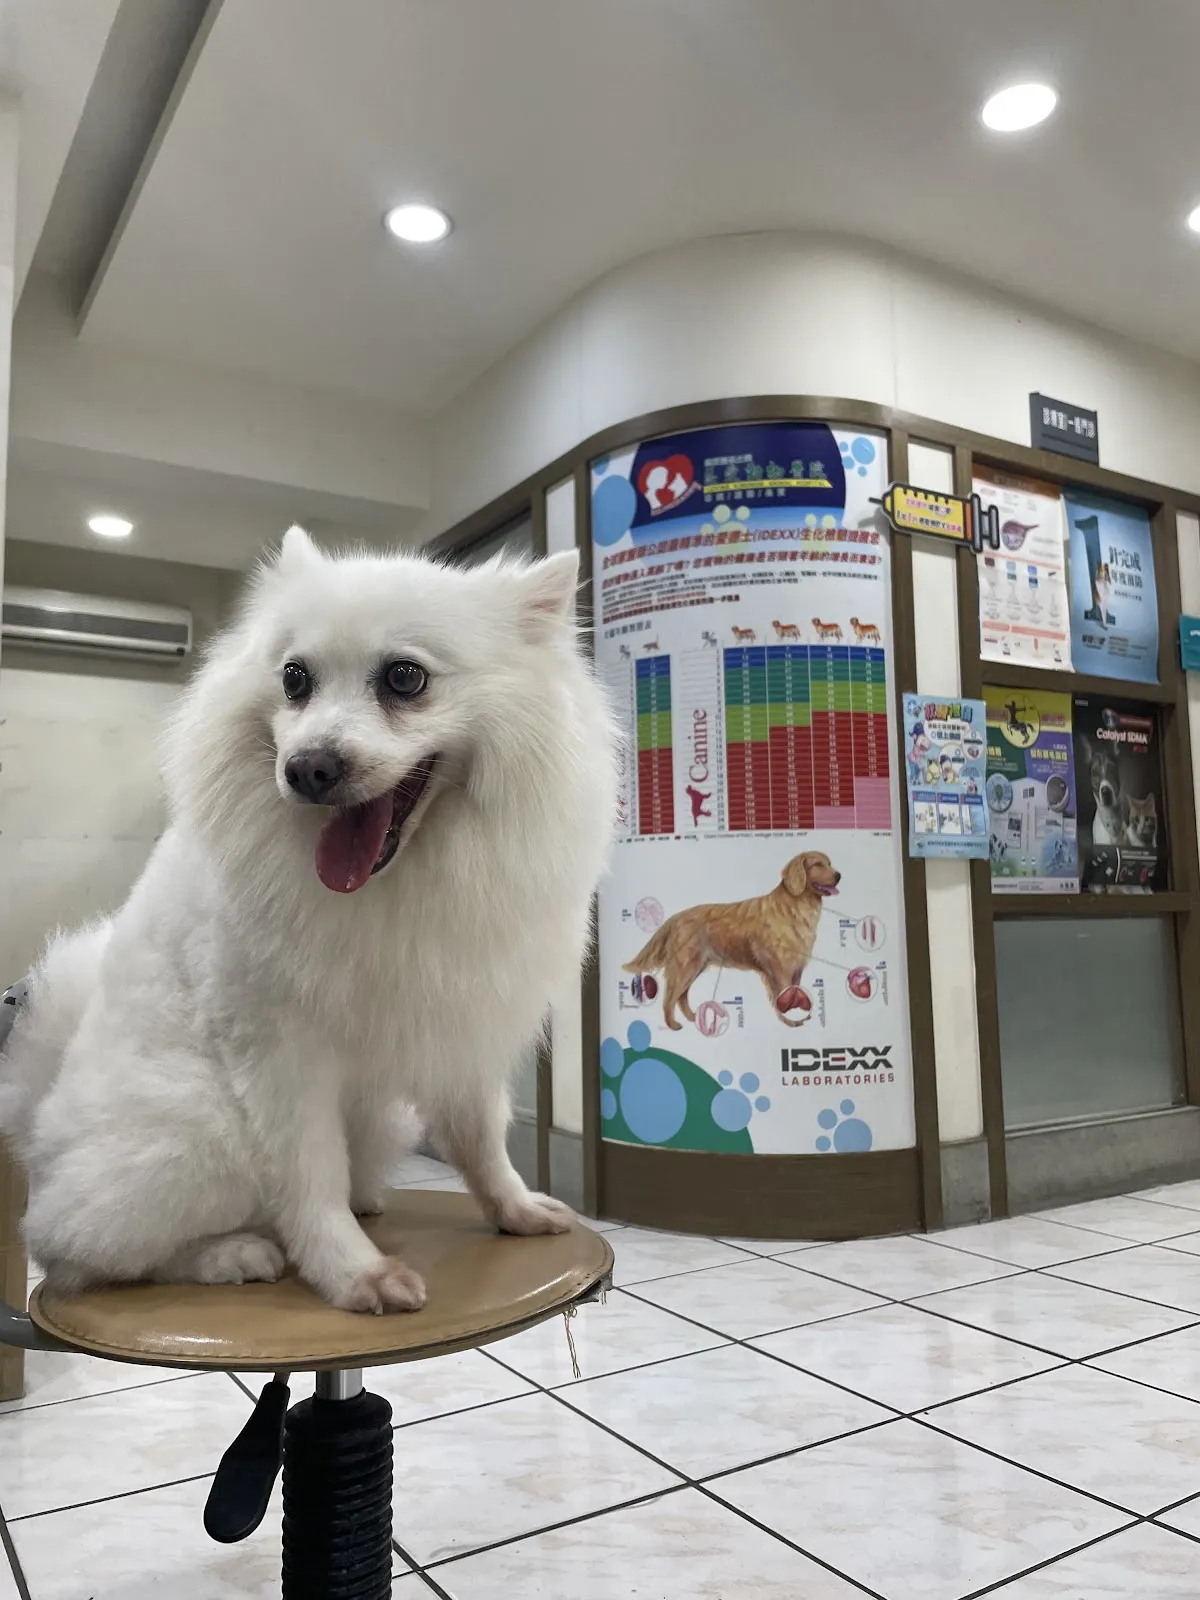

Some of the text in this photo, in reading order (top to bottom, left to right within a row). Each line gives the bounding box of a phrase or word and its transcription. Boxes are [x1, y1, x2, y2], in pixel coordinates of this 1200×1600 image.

[688, 708, 708, 783] Canine
[1096, 727, 1148, 745] Catalyst SDMA
[781, 1046, 894, 1072] IDEXX
[782, 1073, 895, 1086] LABORATORIES
